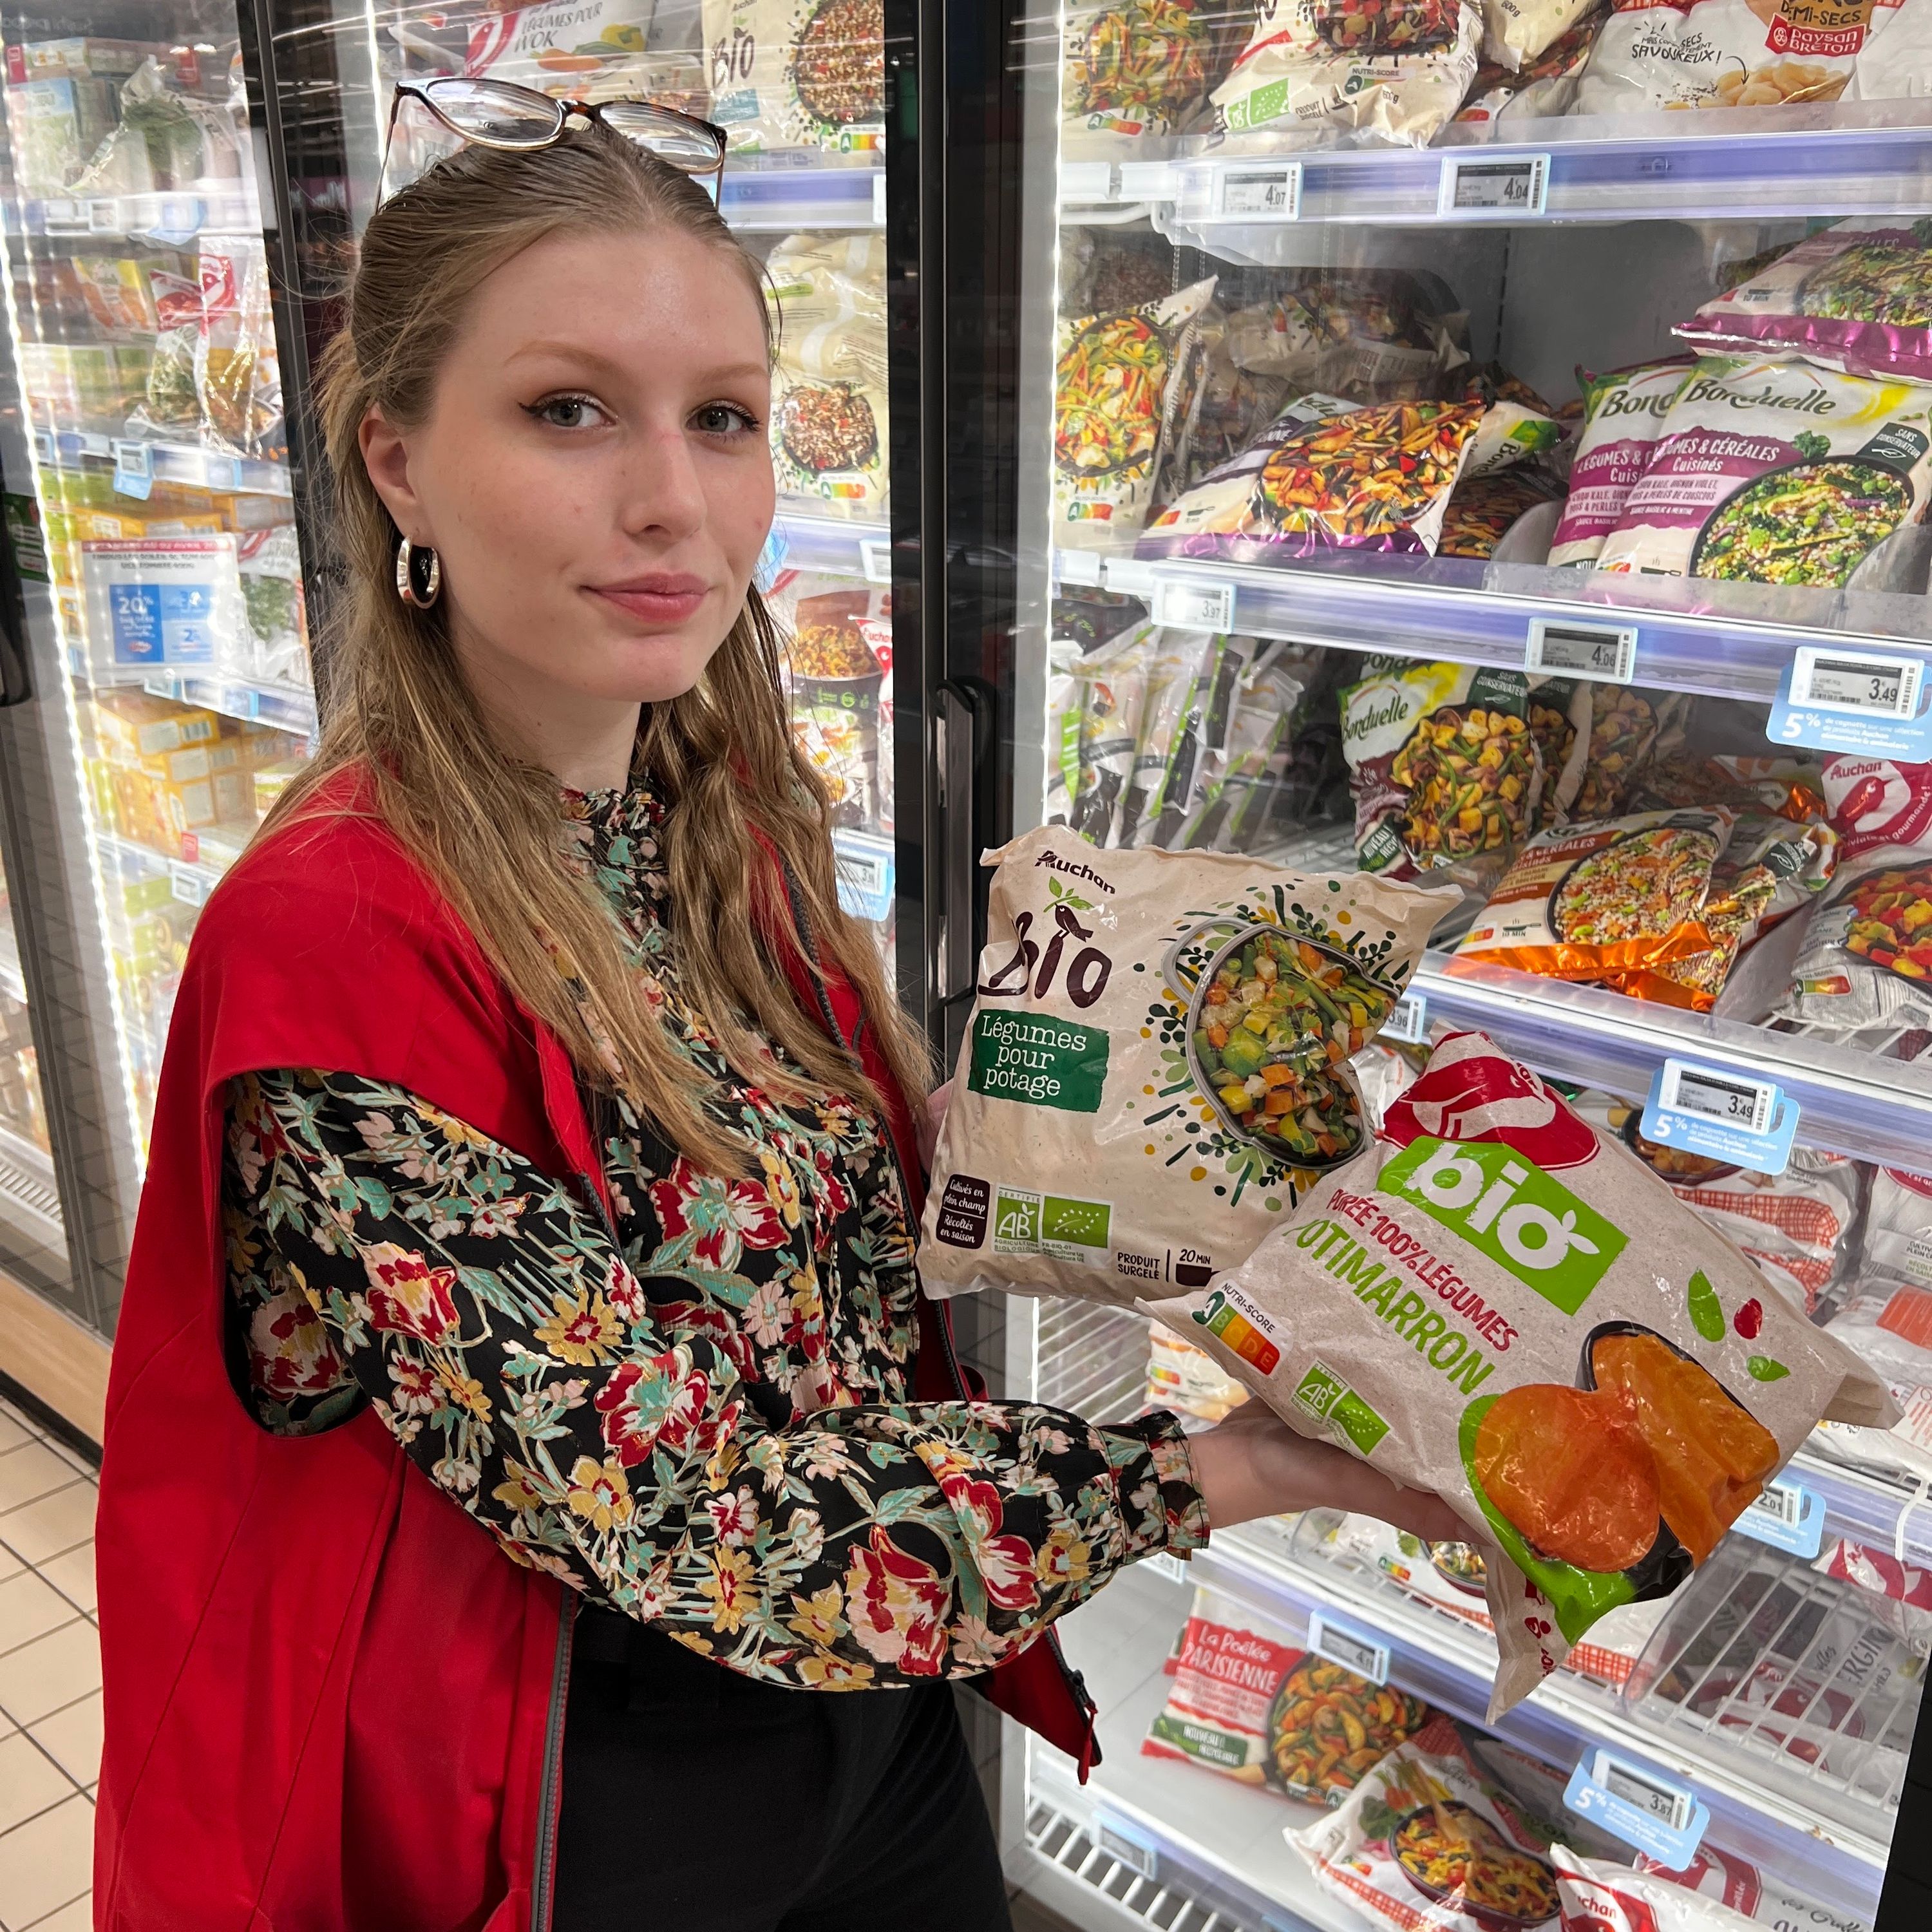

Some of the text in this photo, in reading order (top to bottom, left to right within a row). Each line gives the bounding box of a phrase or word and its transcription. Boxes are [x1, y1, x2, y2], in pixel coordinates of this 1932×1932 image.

[1352, 67, 1399, 77] NUTRI-SCORE
[1685, 379, 1837, 416] Bonduelle
[1875, 433, 1922, 459] CONSERVATEUR
[1895, 428, 1917, 442] SANS
[1710, 436, 1779, 461] CÉRÉALES
[1672, 457, 1724, 473] Cuisinés
[861, 627, 891, 643] Aucha
[1868, 678, 1898, 703] 3.49
[1342, 696, 1409, 741] Bonduelle
[1830, 761, 1882, 781] Auchan
[1034, 850, 1116, 895] Auchan
[981, 1015, 1087, 1052] Légumes
[995, 1044, 1056, 1070] pour
[983, 1067, 1061, 1099] potage
[1728, 1095, 1753, 1118] 3.49
[949, 1179, 984, 1197] Cultivés en
[943, 1193, 986, 1215] plein champ
[1404, 1141, 1576, 1271] bio
[943, 1214, 974, 1231] Récoltés
[998, 1211, 1031, 1239] AB
[940, 1228, 975, 1244] en saison
[994, 1238, 1039, 1248] AGRICULTURE
[1118, 1248, 1211, 1269] PRODUIT 20 MIN
[1326, 1188, 1380, 1227] PURÉE
[1415, 1256, 1519, 1352] LÉGUMES
[1118, 1264, 1160, 1280] SURGELÉ
[1221, 1282, 1275, 1334] NUTRI-SCORE
[1283, 1218, 1495, 1395] OTIMARRON
[1298, 1383, 1329, 1410] AB
[1199, 1624, 1272, 1663] La Poêlée
[1179, 1642, 1279, 1694] PARISIENNE
